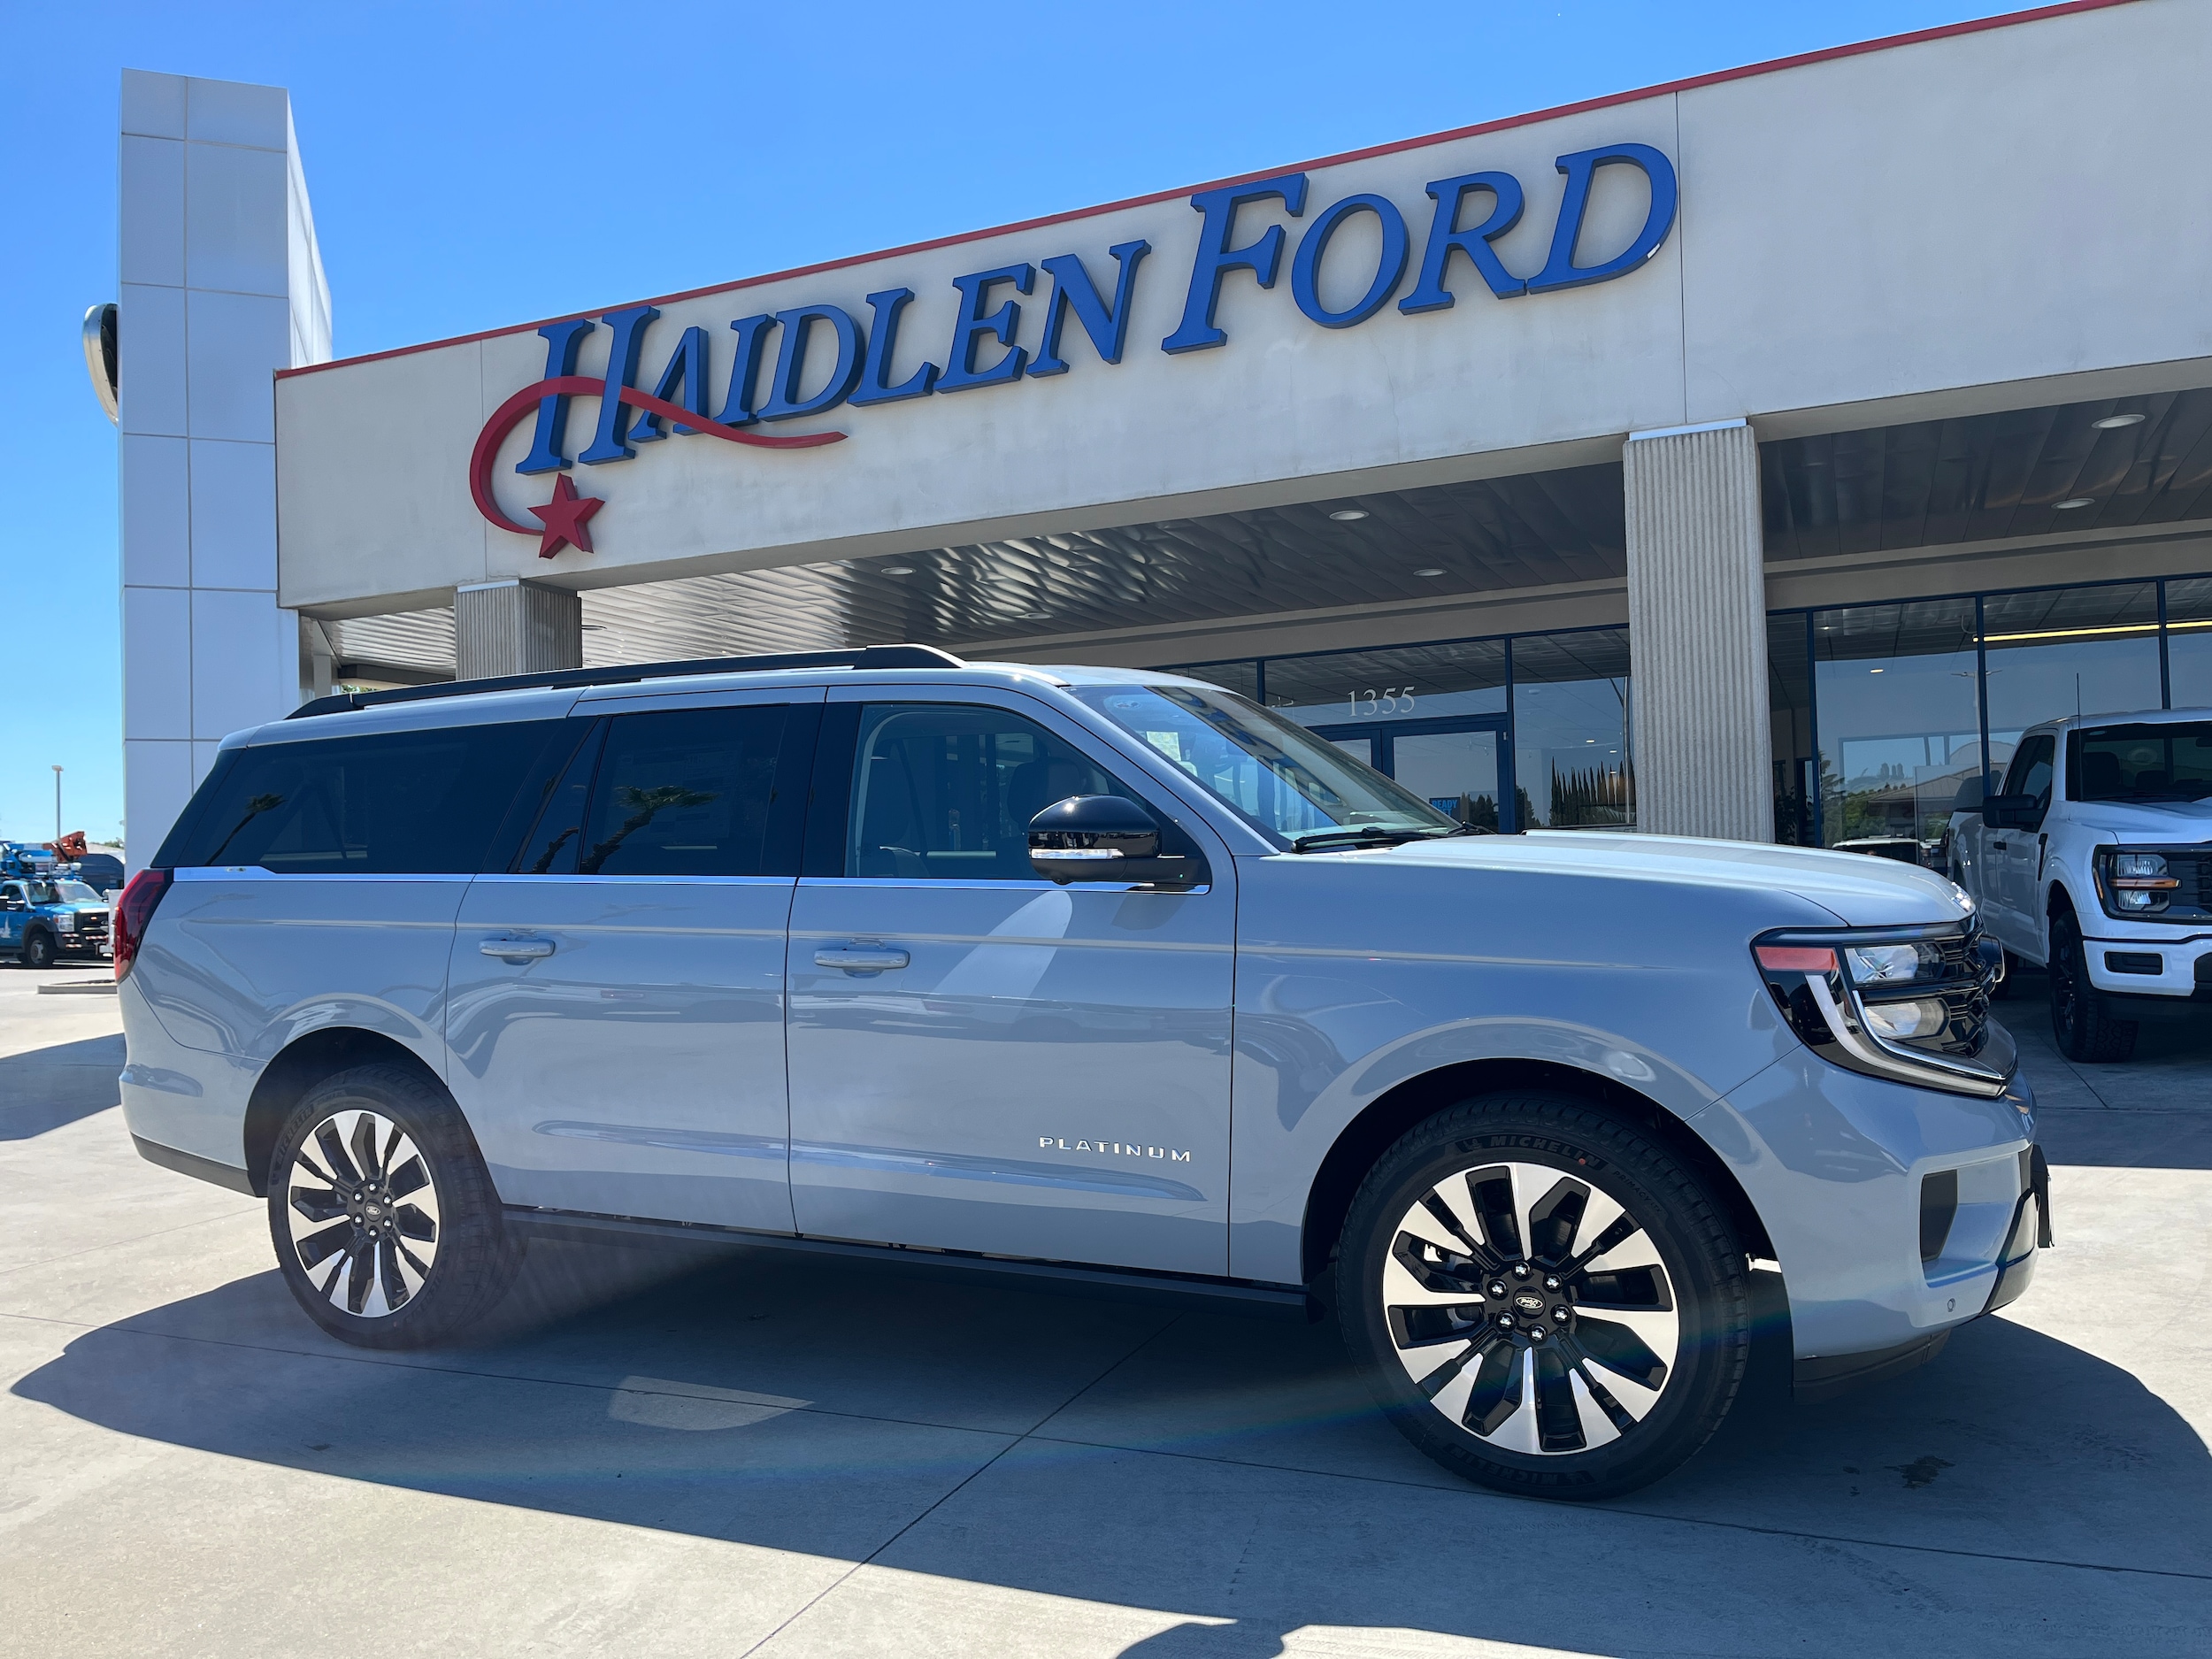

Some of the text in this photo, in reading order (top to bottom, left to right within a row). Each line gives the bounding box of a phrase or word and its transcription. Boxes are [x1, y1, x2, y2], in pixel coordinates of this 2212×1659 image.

[515, 142, 1678, 475] HAIDLEN FORD
[1348, 686, 1415, 717] 1355
[1432, 799, 1458, 809] READY
[277, 1107, 313, 1164] MICHELIN
[1039, 1136, 1191, 1163] PLATINUM
[1490, 1134, 1601, 1167] MICHELIN
[1614, 1171, 1652, 1201] PRIMACY
[1519, 1298, 1540, 1308] Ford
[1450, 1446, 1558, 1485] MICHELIN
